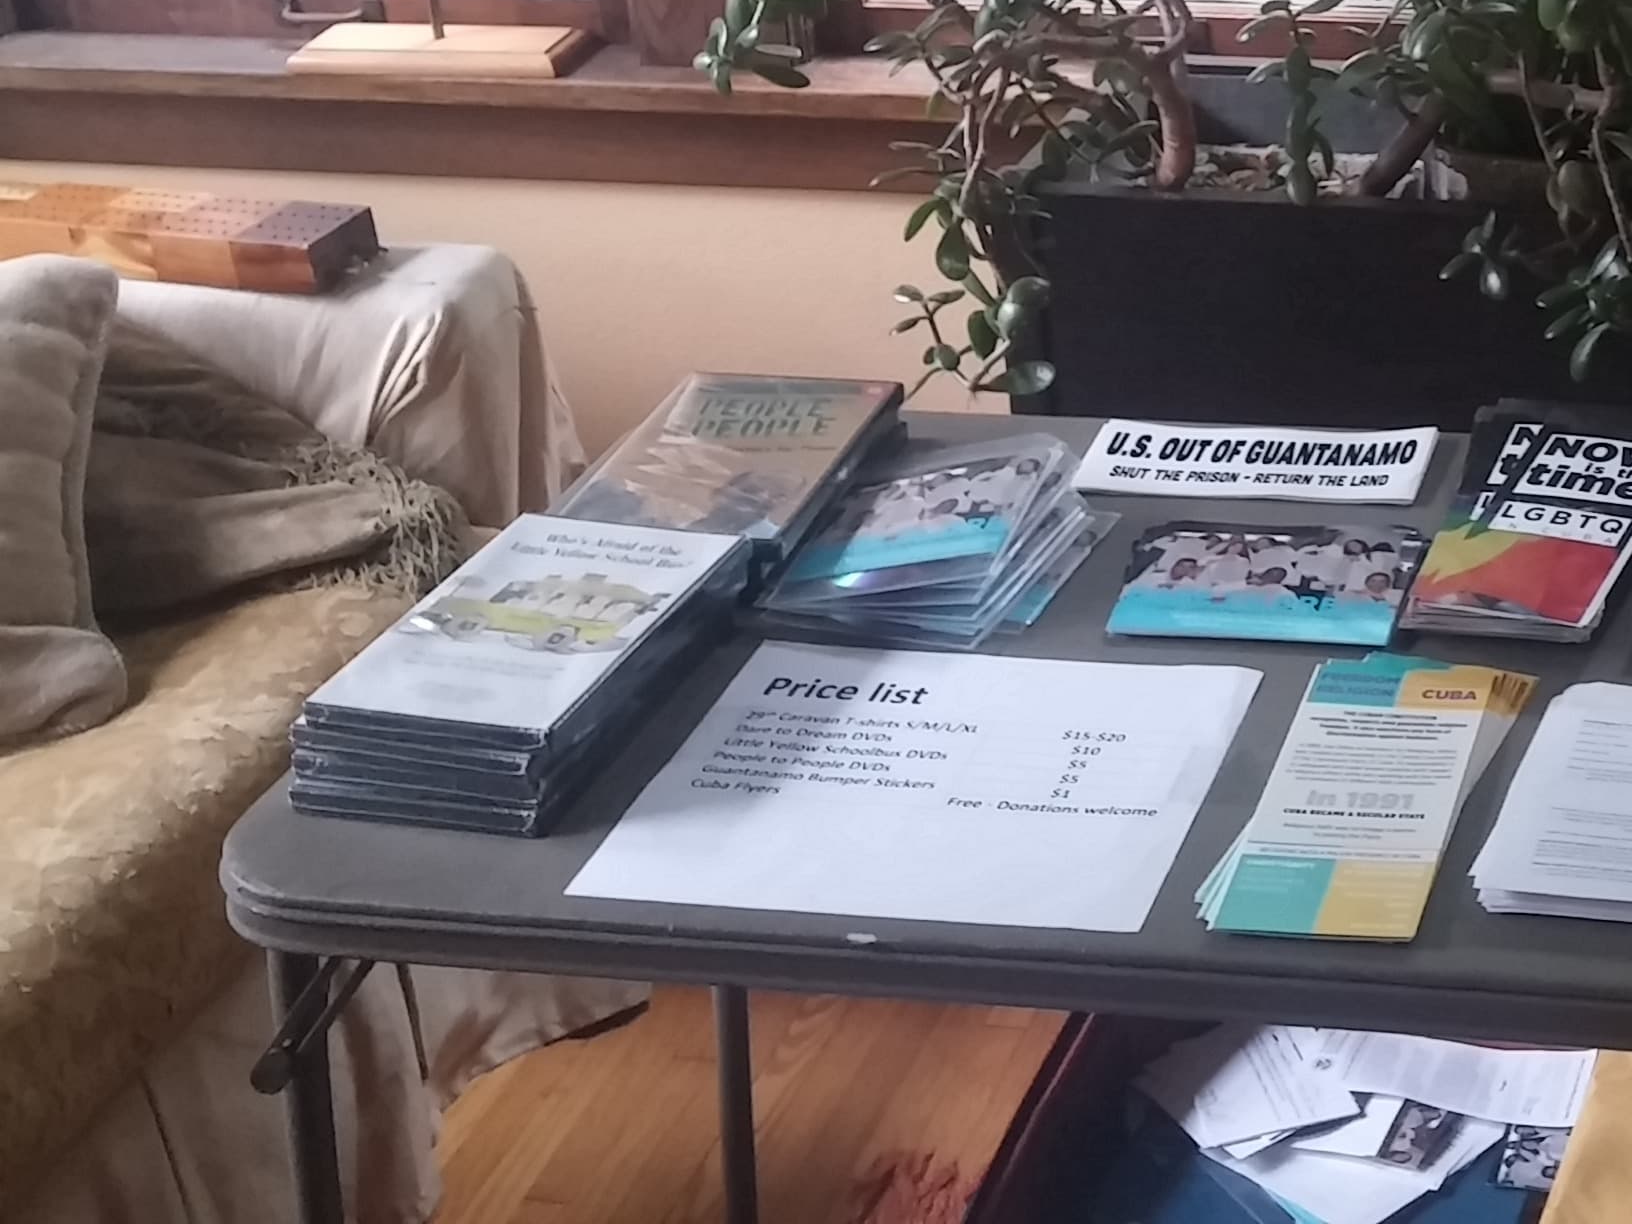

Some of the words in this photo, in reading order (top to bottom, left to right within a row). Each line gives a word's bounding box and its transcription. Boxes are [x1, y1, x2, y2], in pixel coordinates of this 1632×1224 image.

[699, 396, 836, 418] PEOPLE
[691, 417, 837, 438] PEOPLE
[1106, 431, 1153, 460] U.S.
[1159, 437, 1211, 463] OUT
[1211, 438, 1247, 464] OF
[1245, 438, 1419, 467] GUANTANAMO
[1109, 465, 1149, 480] SHUT
[1154, 468, 1183, 482] THE
[1185, 470, 1241, 484] PRISON
[1252, 472, 1315, 487] RETURN
[1318, 474, 1346, 487] THE
[1350, 474, 1390, 488] LAND
[1584, 462, 1604, 475] is
[1501, 503, 1624, 536] LGBTQ
[763, 676, 860, 703] Price
[868, 680, 930, 707] list
[1421, 688, 1478, 702] CUBA
[779, 711, 840, 725] Caravan
[845, 716, 900, 730] T-shirts
[775, 725, 793, 736] to
[796, 727, 848, 740] Dream
[851, 731, 893, 743] DVDs
[1061, 729, 1128, 744] $15-$20
[723, 737, 765, 750] Little
[768, 740, 821, 753] Yellow
[823, 744, 902, 758] Schoolbus
[905, 749, 948, 761] DVDs
[1071, 745, 1102, 758] $10
[712, 750, 768, 765] People
[770, 754, 788, 764] to
[790, 756, 846, 771] People
[849, 760, 891, 773] DVDs
[1067, 759, 1088, 771] $5
[690, 777, 731, 790] Cuba
[733, 781, 782, 796] Flyers
[701, 764, 805, 781] Guantanamo
[807, 772, 870, 787] Bumper
[872, 776, 937, 790] Stickers
[1058, 773, 1080, 785] $5
[1050, 787, 1071, 800] $1
[1305, 789, 1338, 808] In
[1345, 791, 1416, 811] 1991
[946, 796, 983, 809] Free
[996, 799, 1080, 815] Donations
[1083, 805, 1159, 819] welcome
